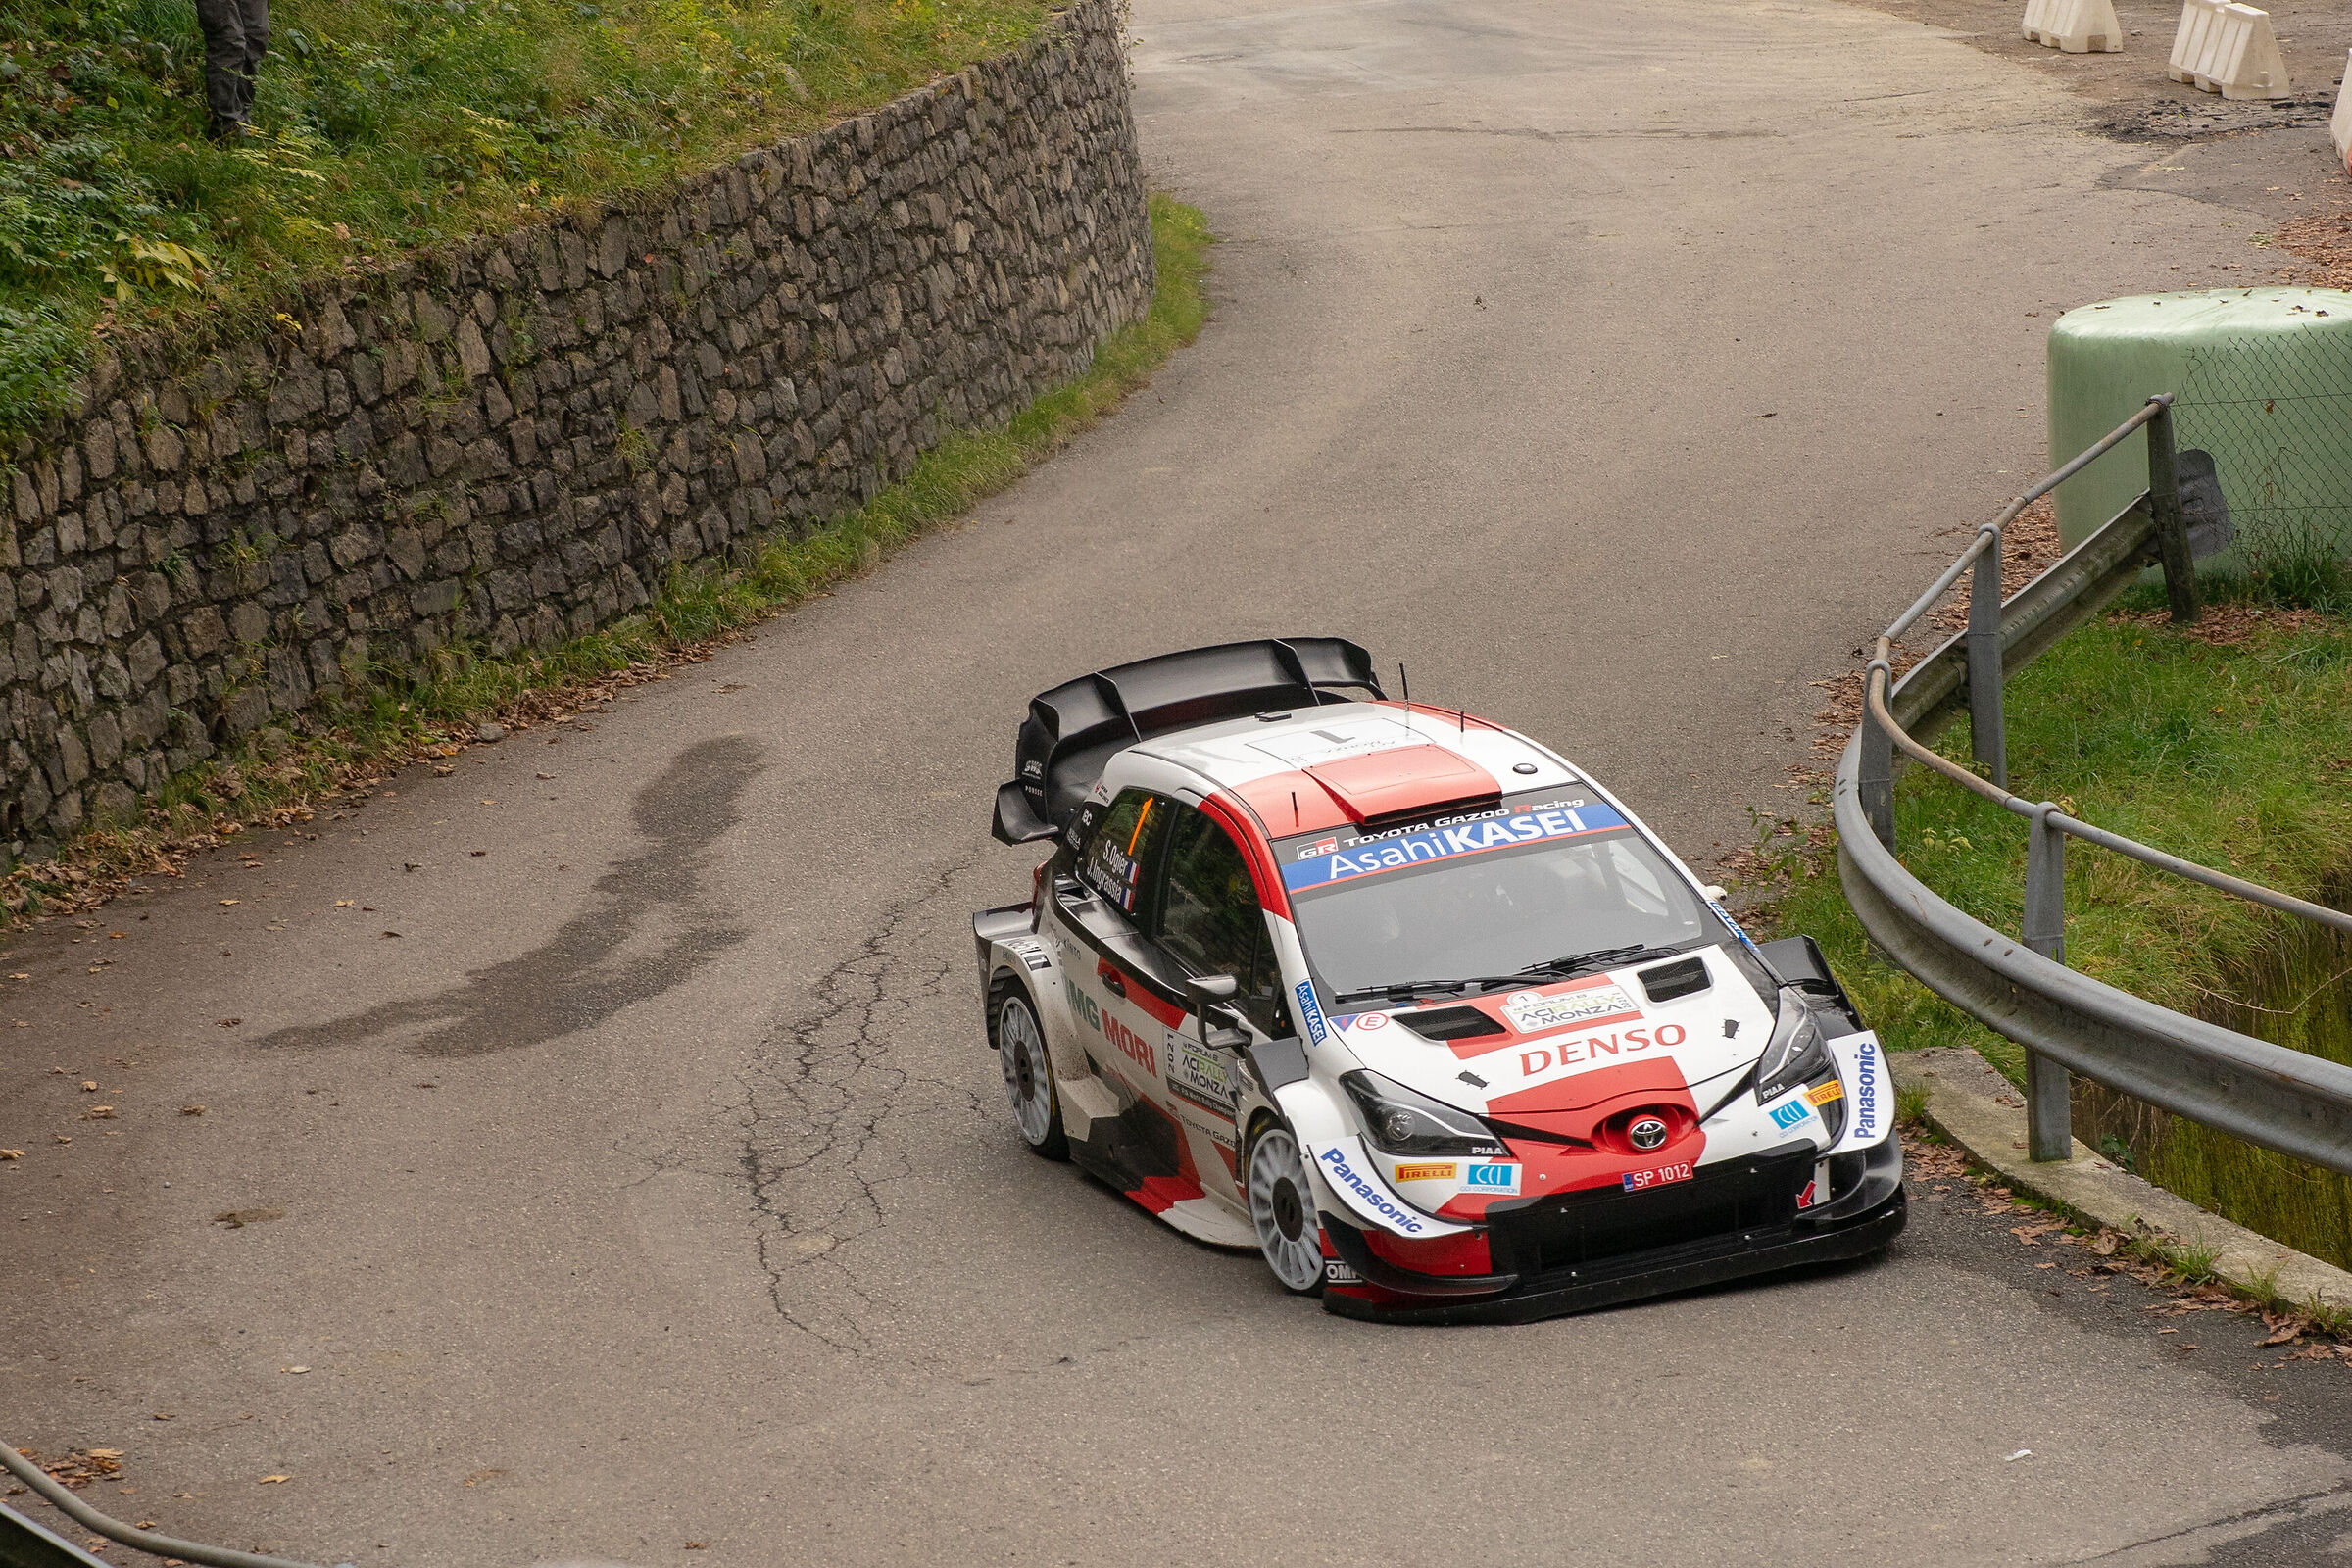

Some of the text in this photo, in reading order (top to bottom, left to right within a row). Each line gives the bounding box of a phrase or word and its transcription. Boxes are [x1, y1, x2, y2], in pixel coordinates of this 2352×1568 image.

[1128, 797, 1153, 856] 1
[1330, 809, 1587, 879] AsahiKASEI
[1343, 799, 1585, 846] TOYOTA GAZOO Racing
[1102, 839, 1128, 877] S.Ogier
[1299, 843, 1338, 858] GR
[1087, 856, 1122, 905] J.Ingrassia
[1298, 984, 1325, 1043] AsahiKASEI
[1542, 1004, 1622, 1024] MONZA
[1102, 1007, 1157, 1078] MORI
[1520, 1025, 1686, 1076] DENSO
[1191, 1071, 1228, 1098] MONZA
[1762, 1084, 1785, 1098] PIAA
[1854, 1043, 1875, 1138] Panasonic
[1320, 1148, 1423, 1233] Panasonic
[1398, 1165, 1453, 1179] PIRELLI
[1634, 1163, 1690, 1187] SP 1012
